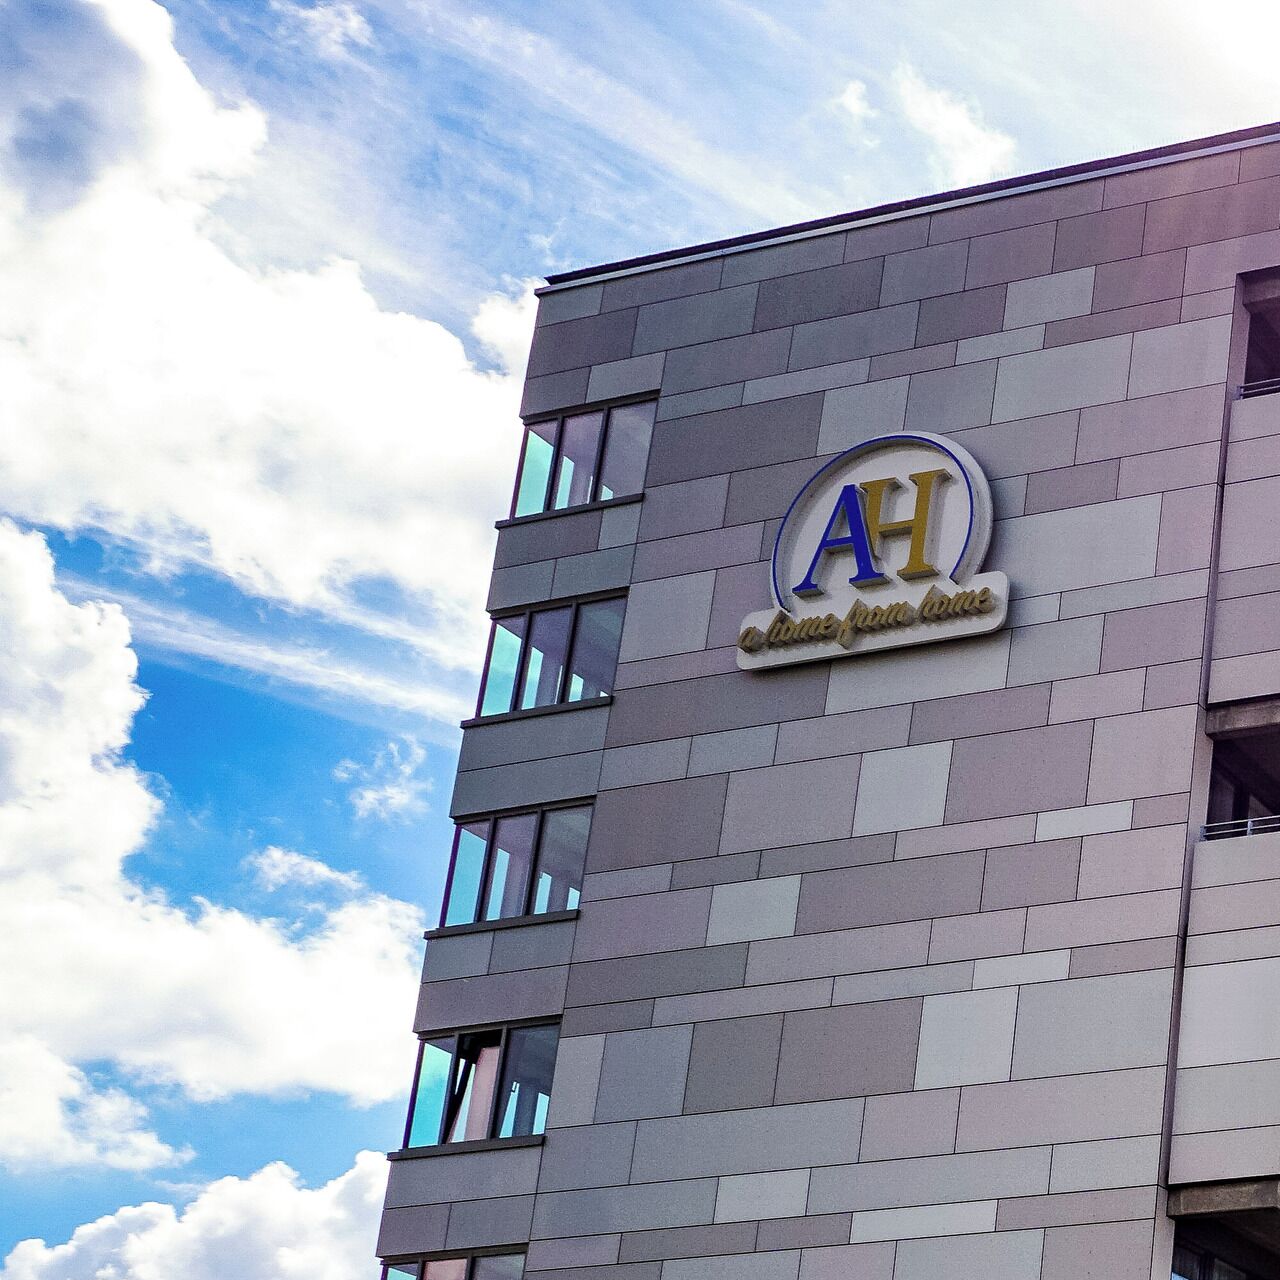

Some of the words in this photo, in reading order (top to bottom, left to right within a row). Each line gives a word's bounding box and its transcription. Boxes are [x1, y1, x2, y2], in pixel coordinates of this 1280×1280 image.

[791, 468, 950, 596] AH
[764, 609, 841, 650] home
[836, 598, 916, 650] from
[917, 583, 994, 624] home
